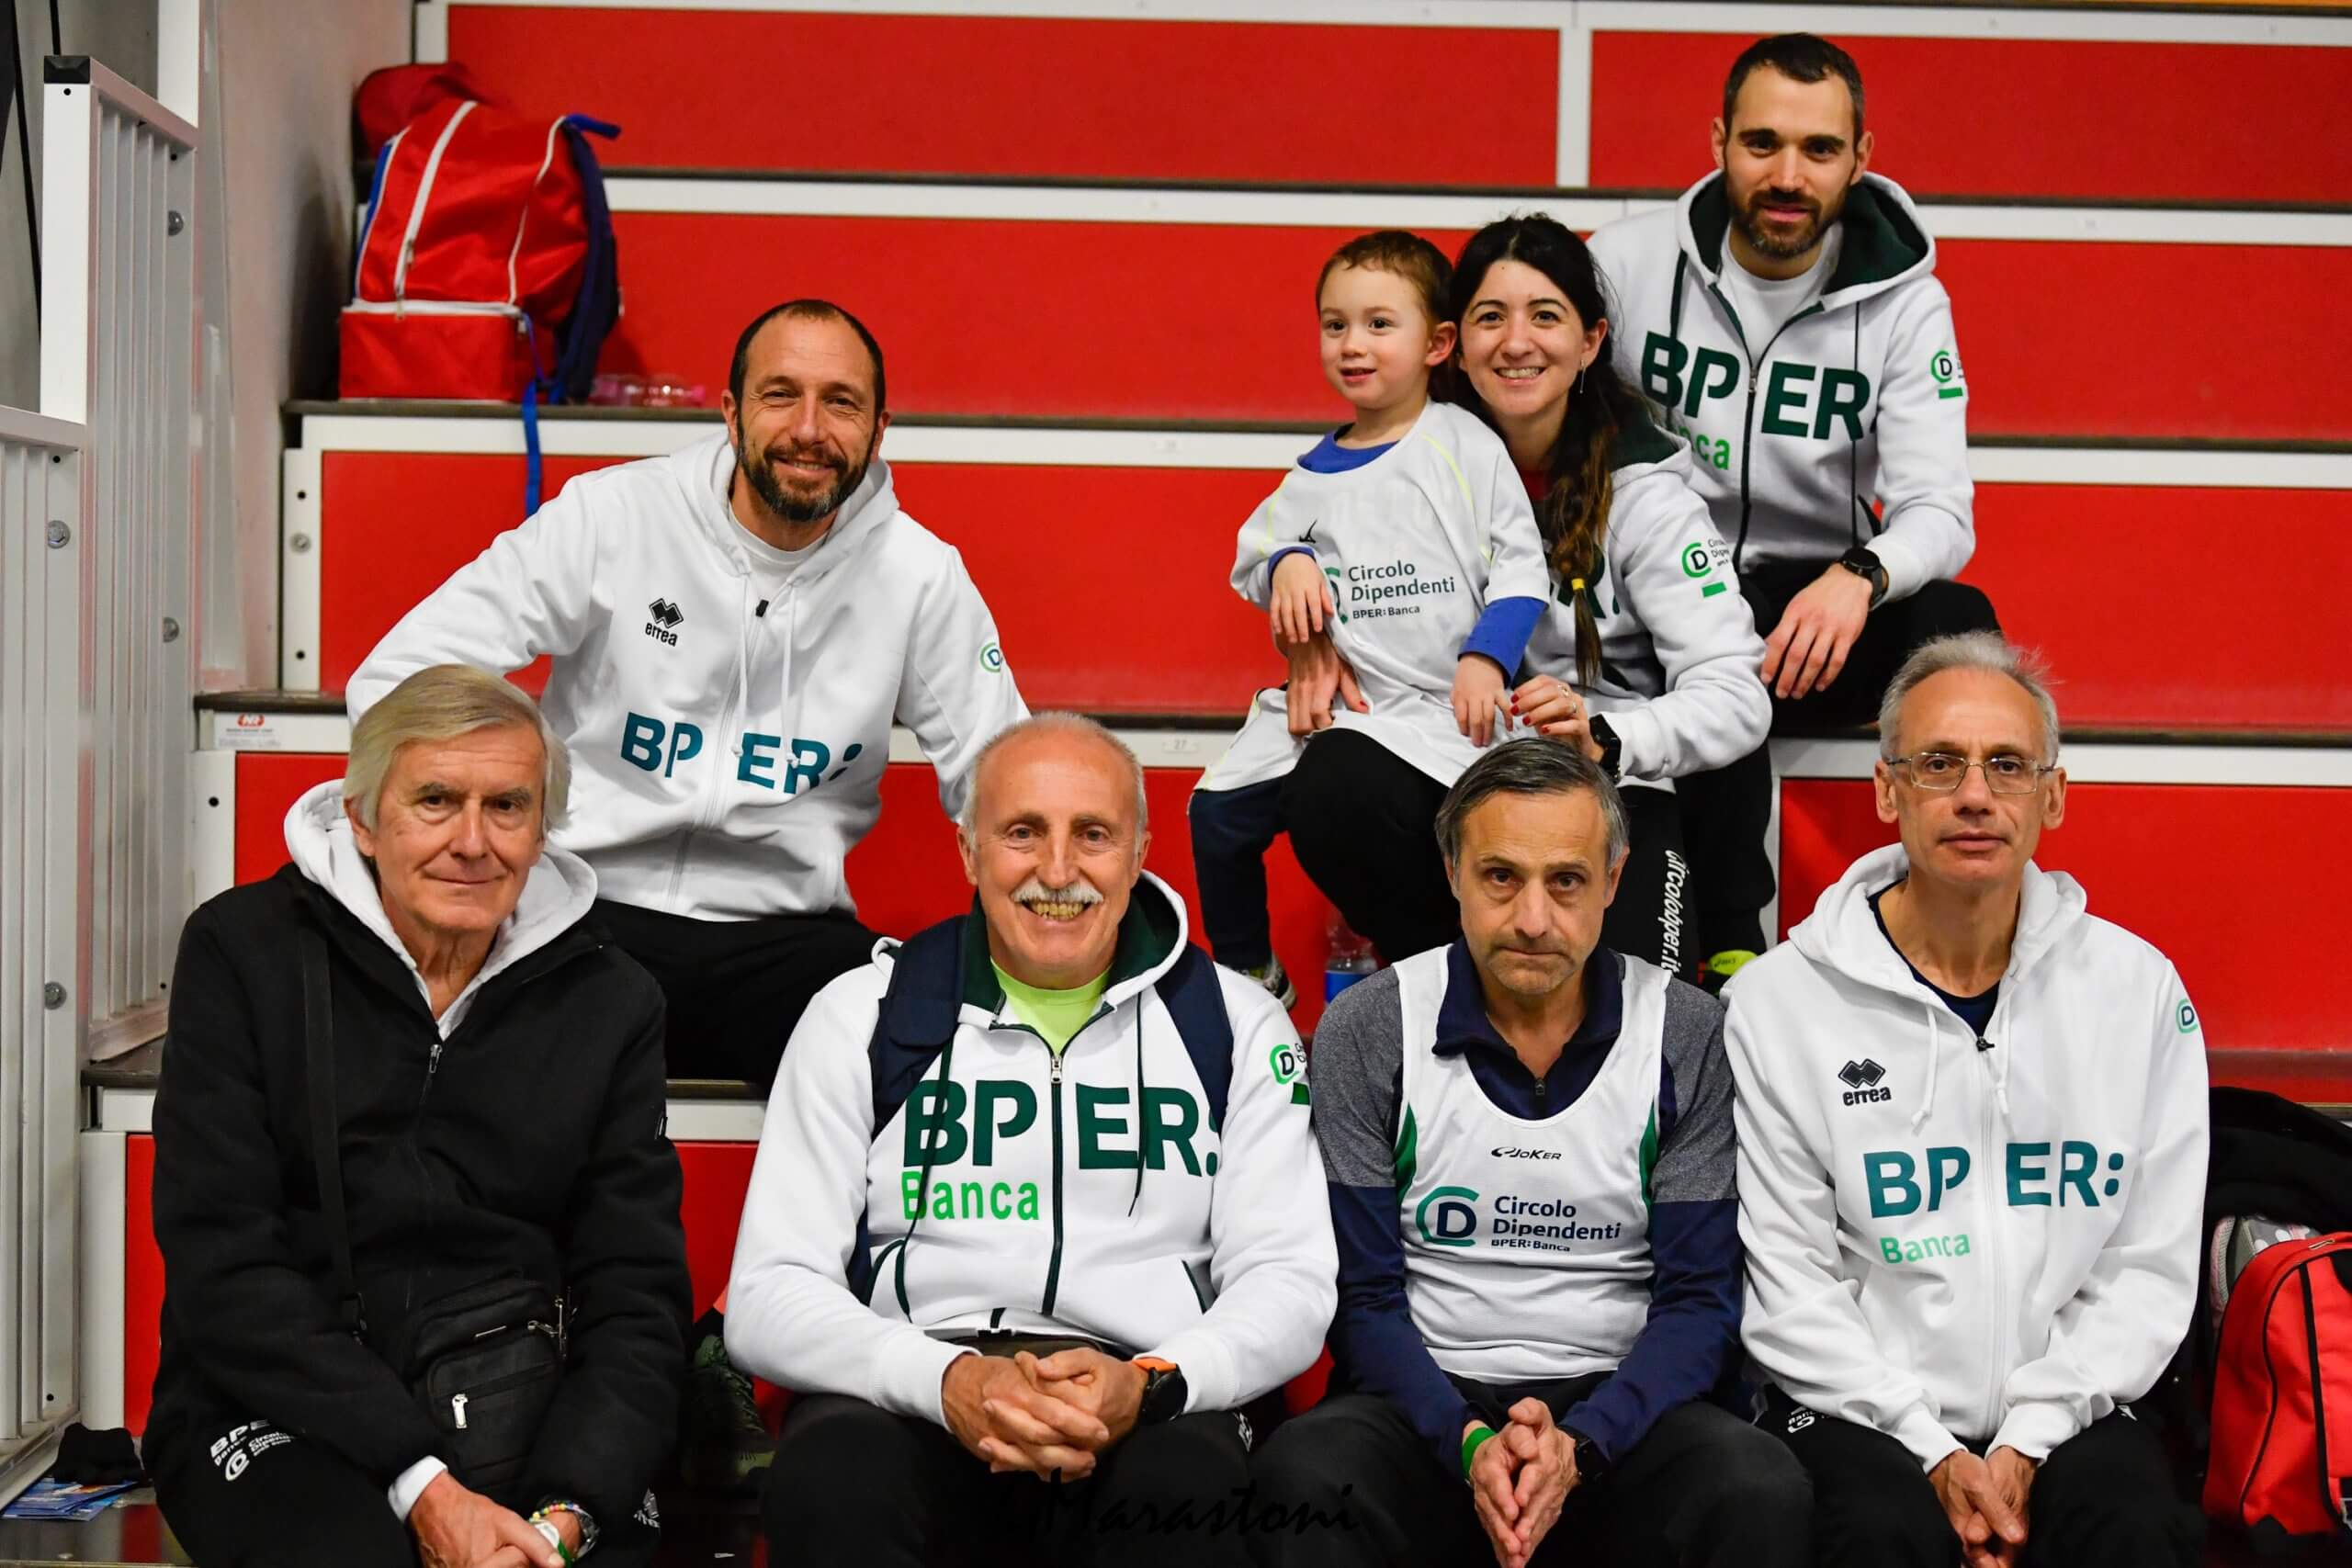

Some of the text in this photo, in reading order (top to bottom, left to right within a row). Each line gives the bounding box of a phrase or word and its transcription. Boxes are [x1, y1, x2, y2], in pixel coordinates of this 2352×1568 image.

[1348, 559, 1416, 582] Circolo
[1351, 577, 1456, 604] Dipendenti
[1842, 1087, 1892, 1106] errea
[900, 1170, 1040, 1222] Banca
[1494, 1195, 1577, 1219] Circolo
[1492, 1218, 1622, 1241] Dipendenti
[1879, 1234, 1972, 1265] Banca
